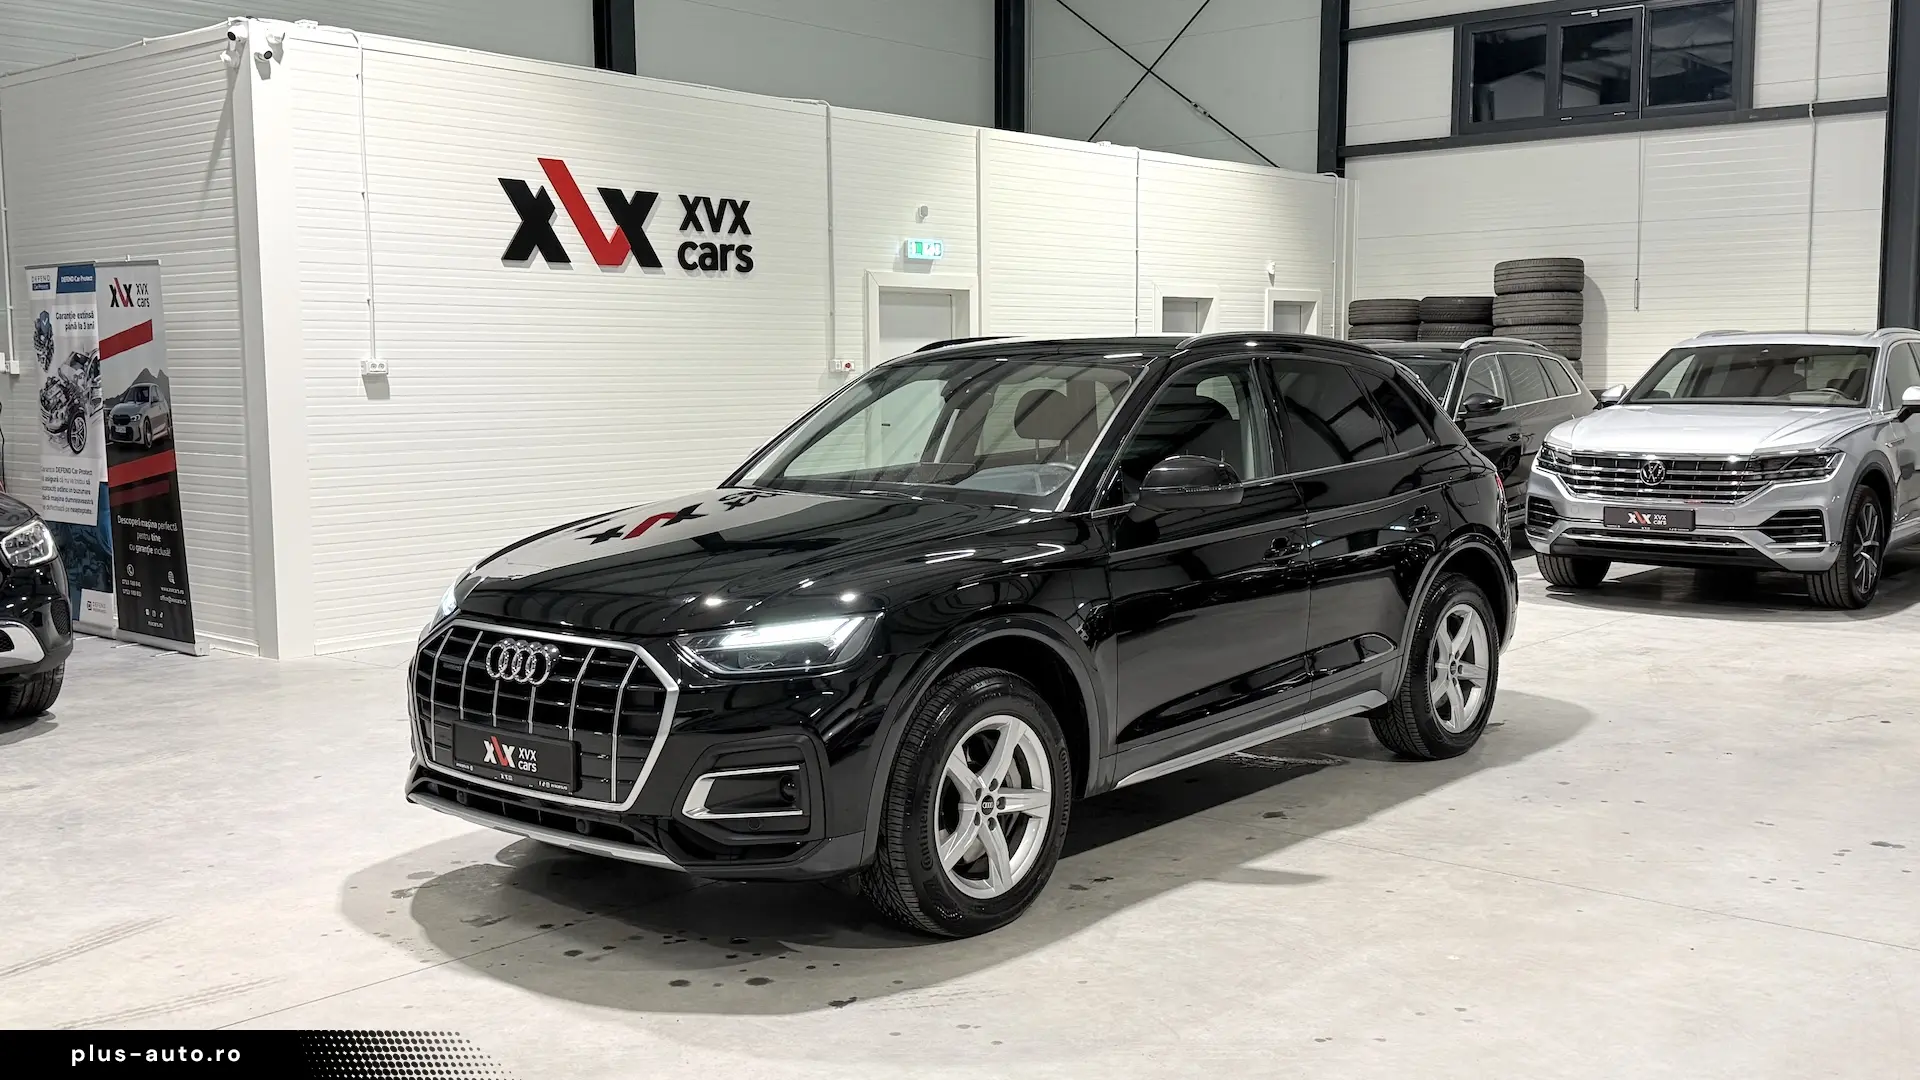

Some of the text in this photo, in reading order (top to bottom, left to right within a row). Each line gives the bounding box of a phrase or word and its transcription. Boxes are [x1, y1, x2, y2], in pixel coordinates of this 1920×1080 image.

[498, 158, 663, 268] XVX
[677, 193, 752, 236] XVX
[677, 239, 754, 273] cars
[109, 277, 134, 308] XVX
[135, 283, 149, 295] XVX
[137, 297, 150, 308] cars
[483, 735, 516, 768] XVX
[518, 747, 537, 762] XVX
[518, 760, 538, 773] cars
